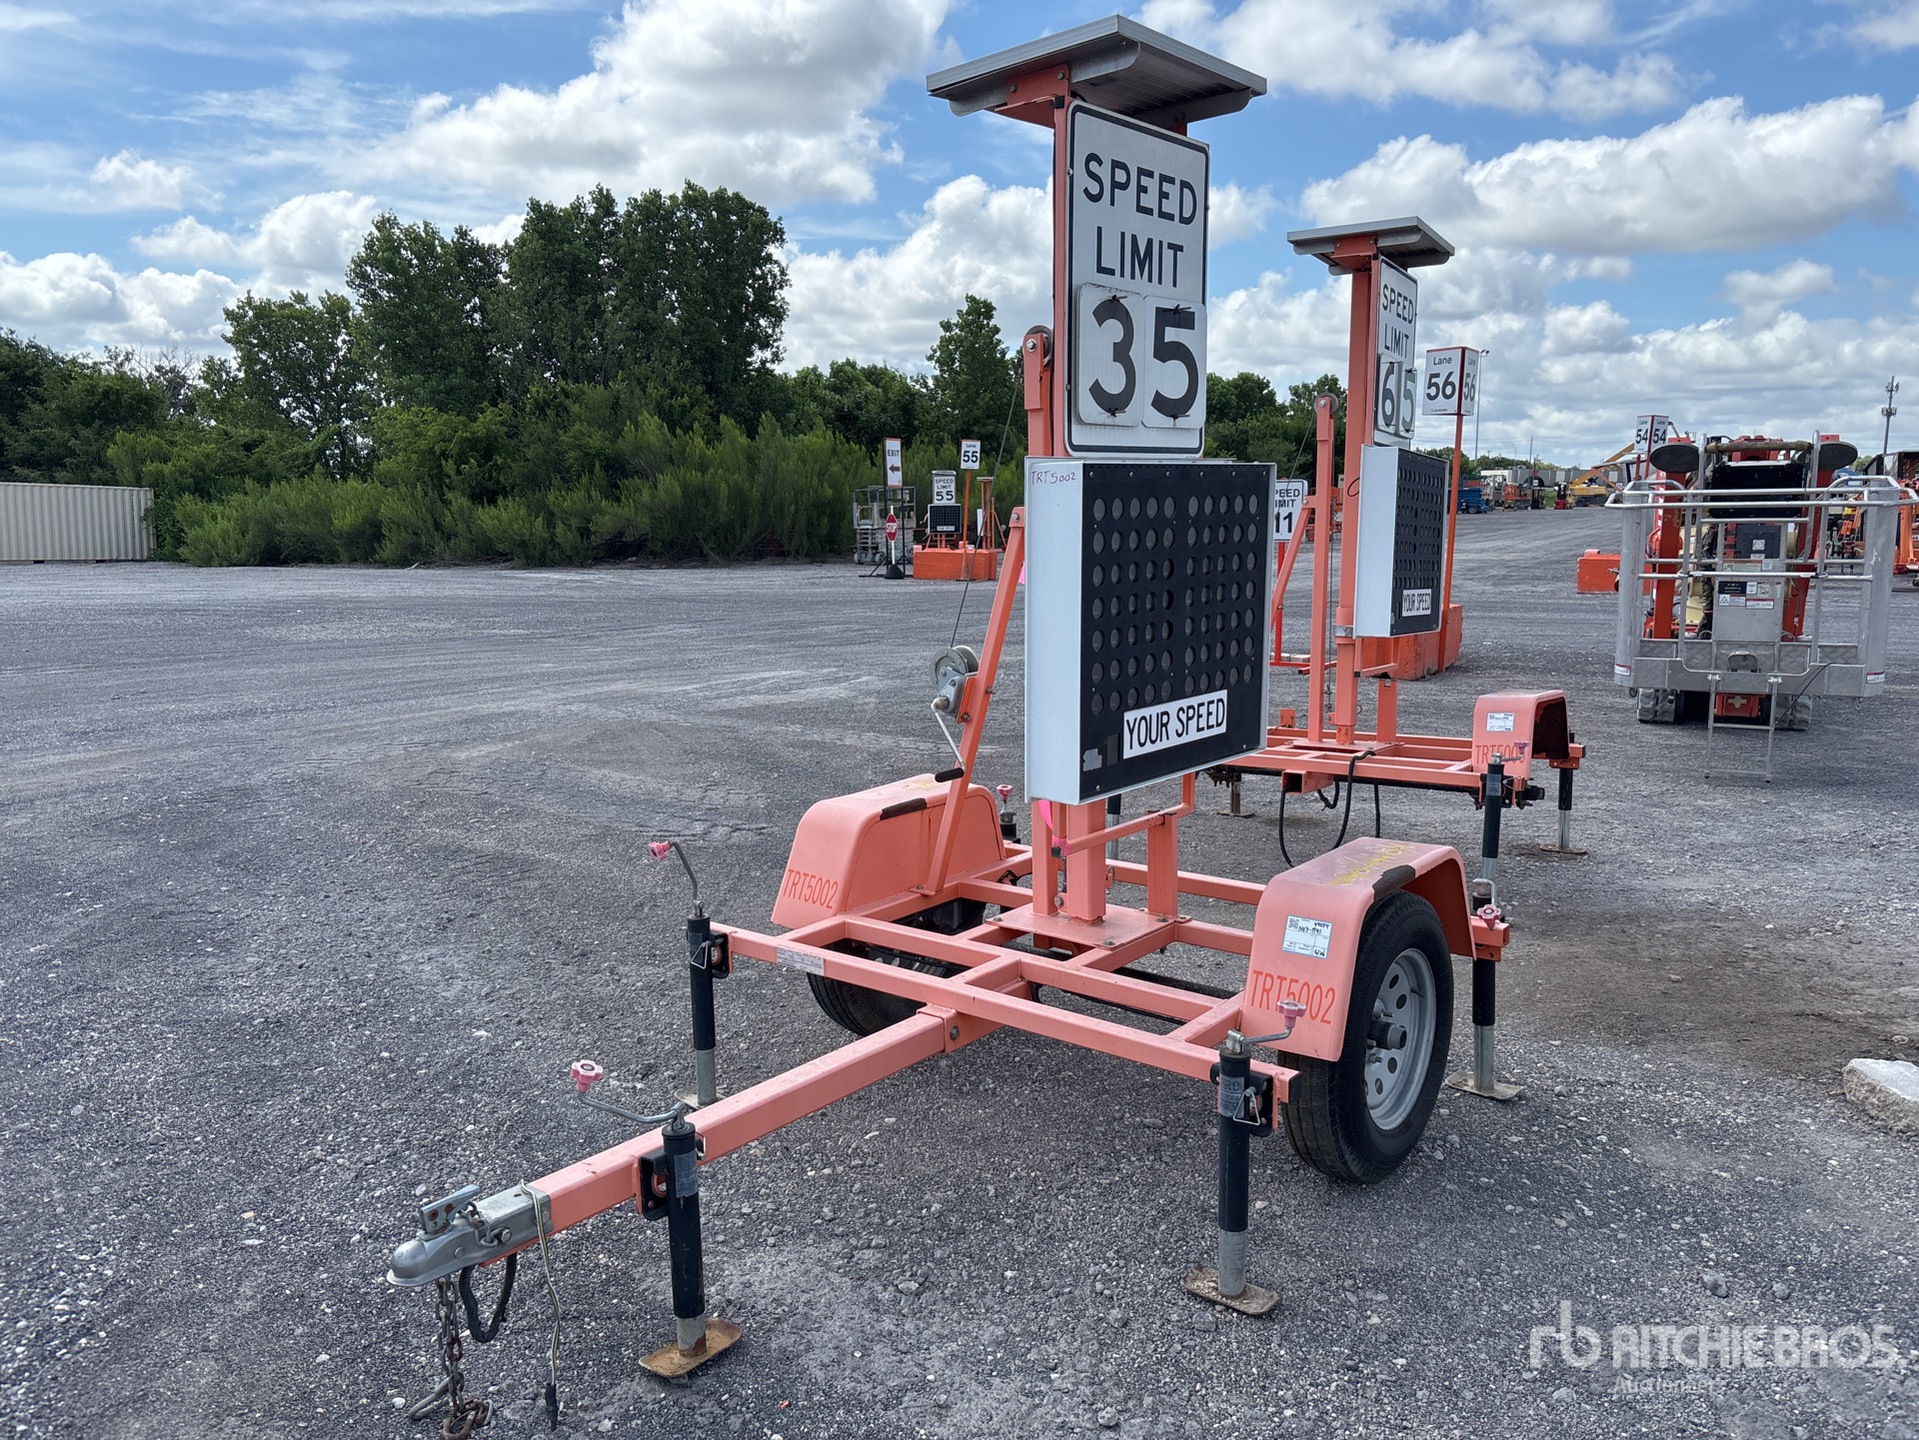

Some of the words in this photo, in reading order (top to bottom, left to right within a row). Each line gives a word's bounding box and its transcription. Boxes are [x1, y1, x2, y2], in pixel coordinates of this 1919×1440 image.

[1083, 152, 1198, 226] SPEED
[1096, 226, 1185, 288] LIMIT
[1382, 283, 1415, 325] SPEED
[1384, 323, 1410, 360] LIMIT
[1088, 298, 1200, 418] 35
[1433, 356, 1453, 366] Lane
[1381, 362, 1416, 433] 65
[1426, 371, 1457, 401] 56
[1463, 372, 1476, 402] 56
[1635, 428, 1649, 444] 54
[1652, 428, 1667, 444] 54
[887, 449, 900, 457] EXIT
[962, 450, 979, 463] 55
[1031, 470, 1077, 486] TRT5002
[1275, 488, 1301, 498] EED
[936, 490, 954, 502] 55
[1275, 499, 1296, 508] IMIT
[1416, 592, 1431, 611] SPEED
[1126, 710, 1170, 750] YOUR
[1175, 698, 1226, 738] SPEED
[783, 869, 839, 909] TRT5002
[1250, 970, 1336, 1025] TRT5002
